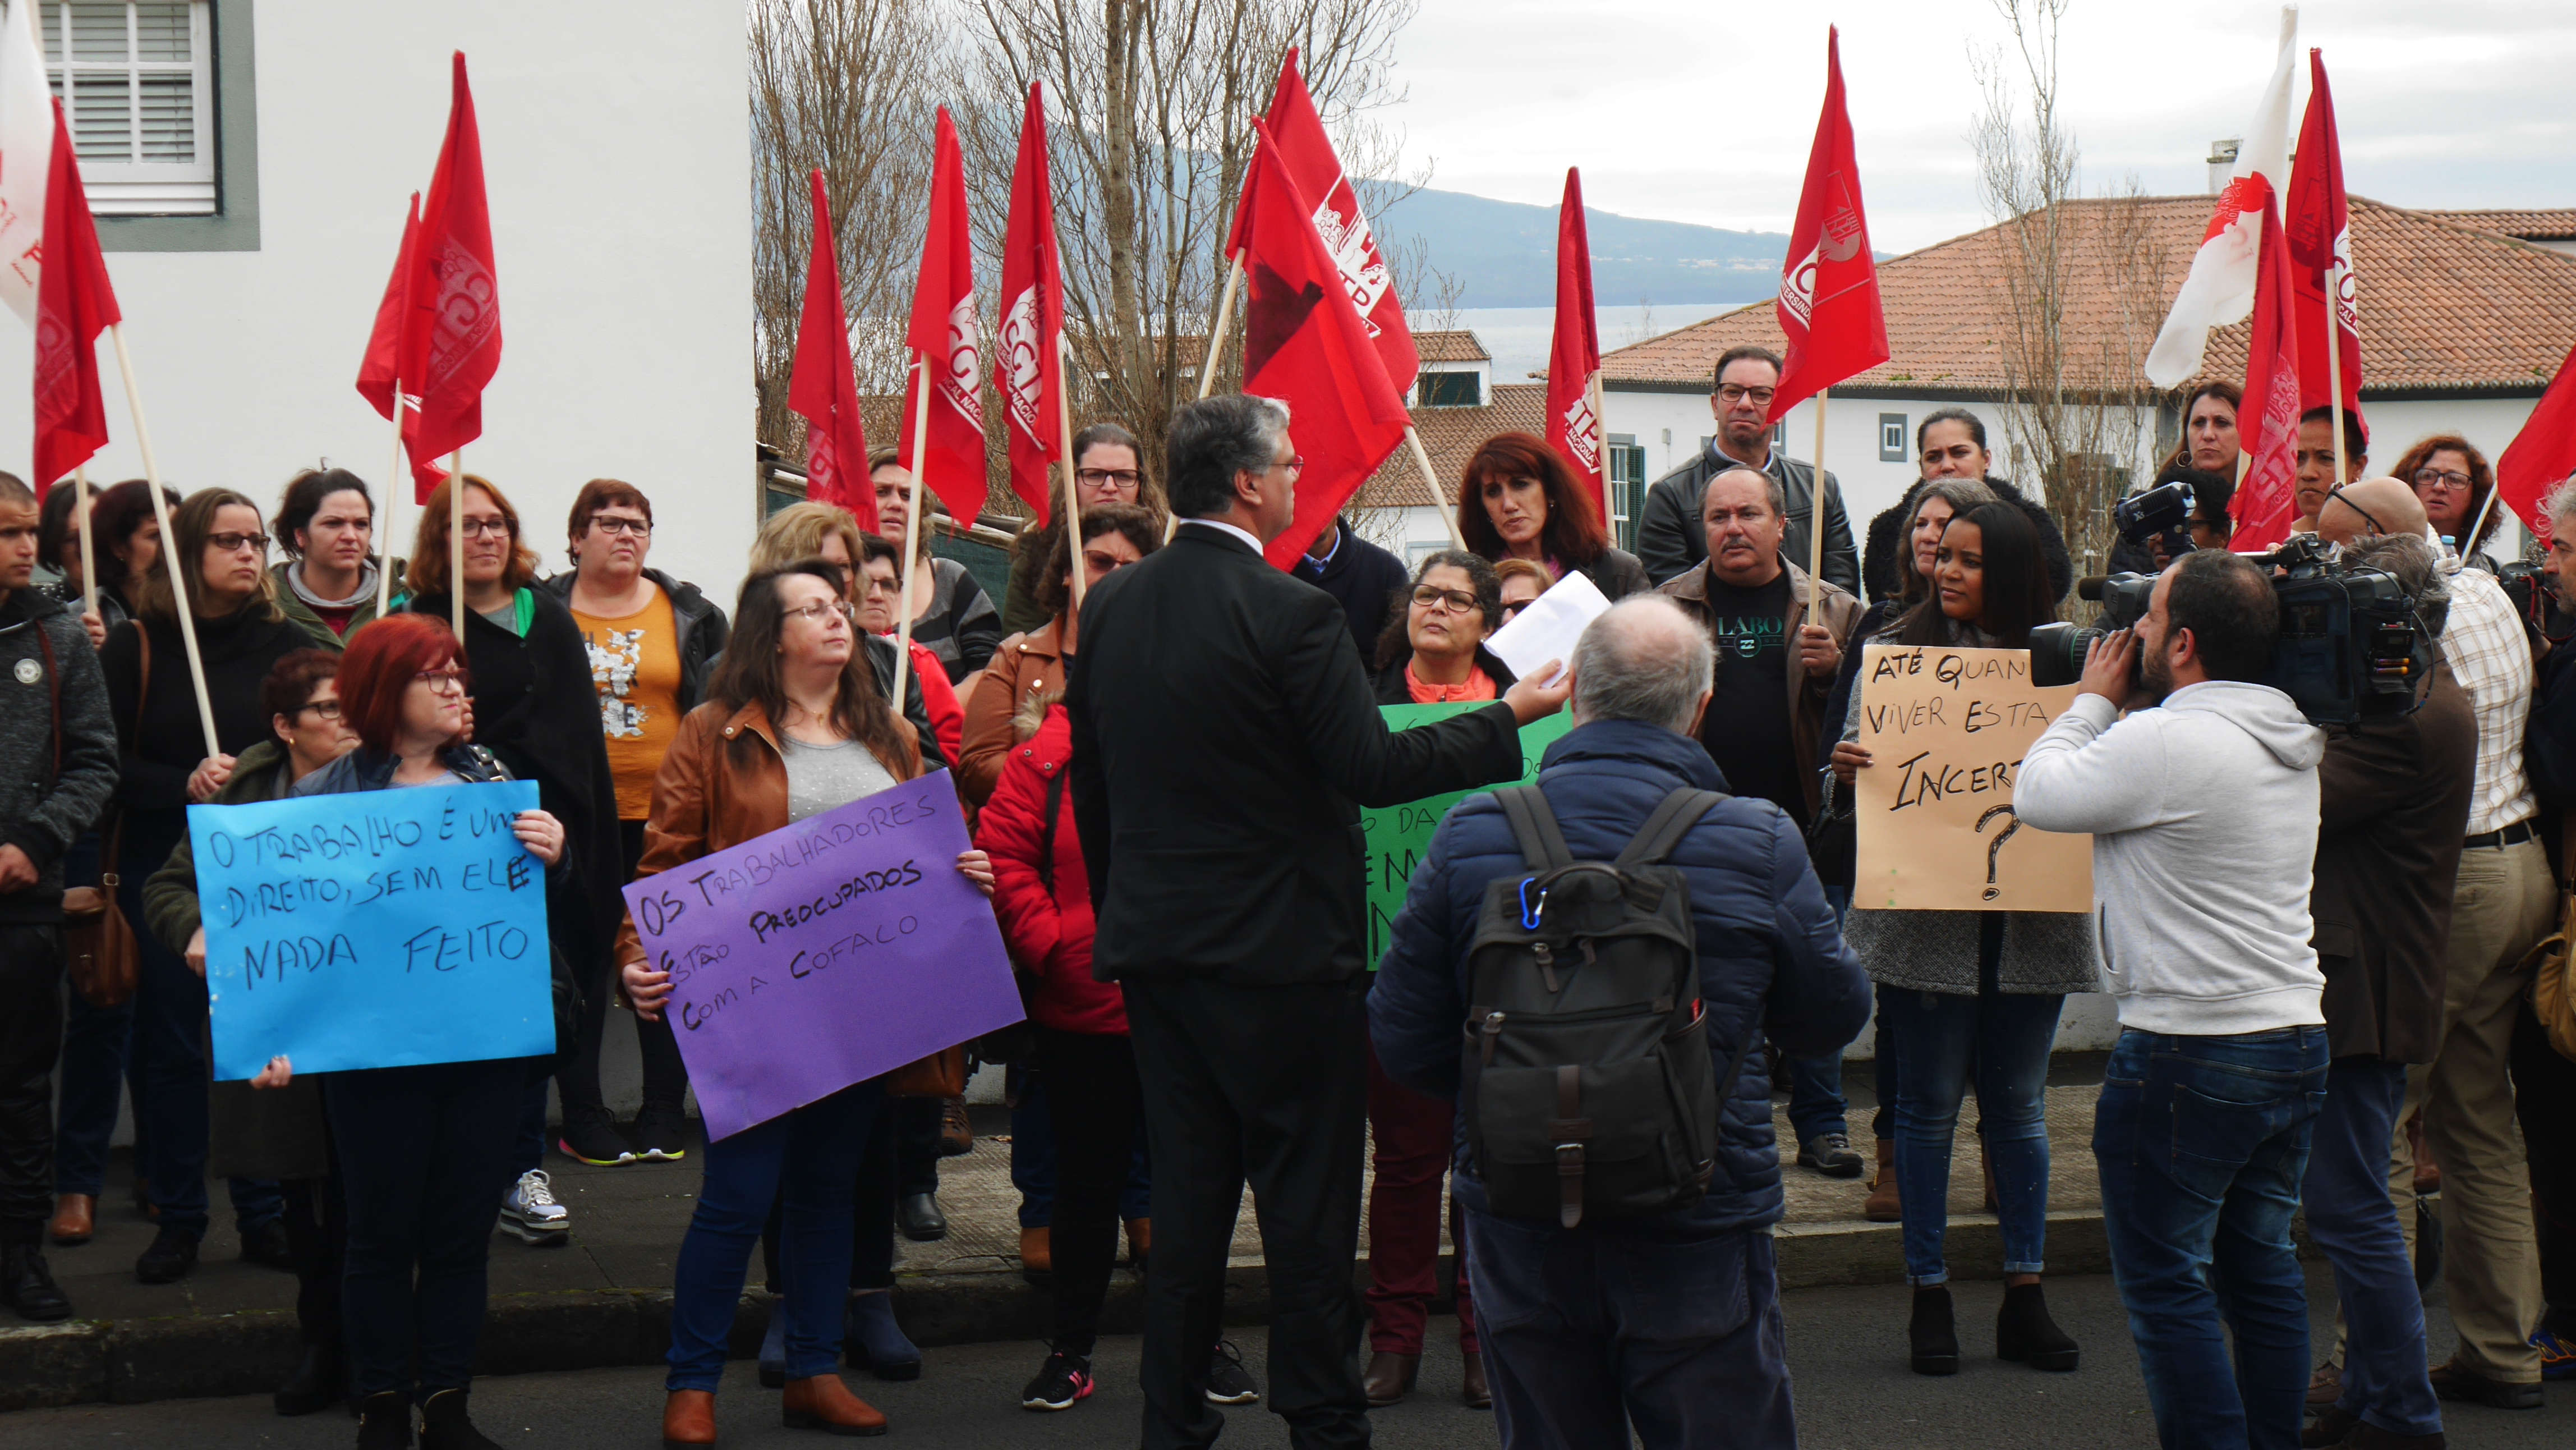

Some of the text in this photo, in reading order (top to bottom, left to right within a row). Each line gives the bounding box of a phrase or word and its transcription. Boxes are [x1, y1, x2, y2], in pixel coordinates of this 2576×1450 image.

[1717, 616, 1783, 635] LABO
[1872, 646, 2027, 690] ATÉ QUAN
[1867, 696, 1947, 733] VIVER
[210, 832, 234, 868] O
[244, 815, 422, 865] TRABALHO
[439, 796, 455, 840] É
[1974, 804, 2023, 901] ?
[353, 866, 442, 906] SEM
[462, 854, 530, 892] ELE
[640, 794, 936, 937] OS TRABALHADORES
[749, 859, 922, 944] PREOCUPADOS
[244, 920, 528, 991] NADA FEITO
[681, 987, 738, 1031] COM
[749, 976, 769, 995] A
